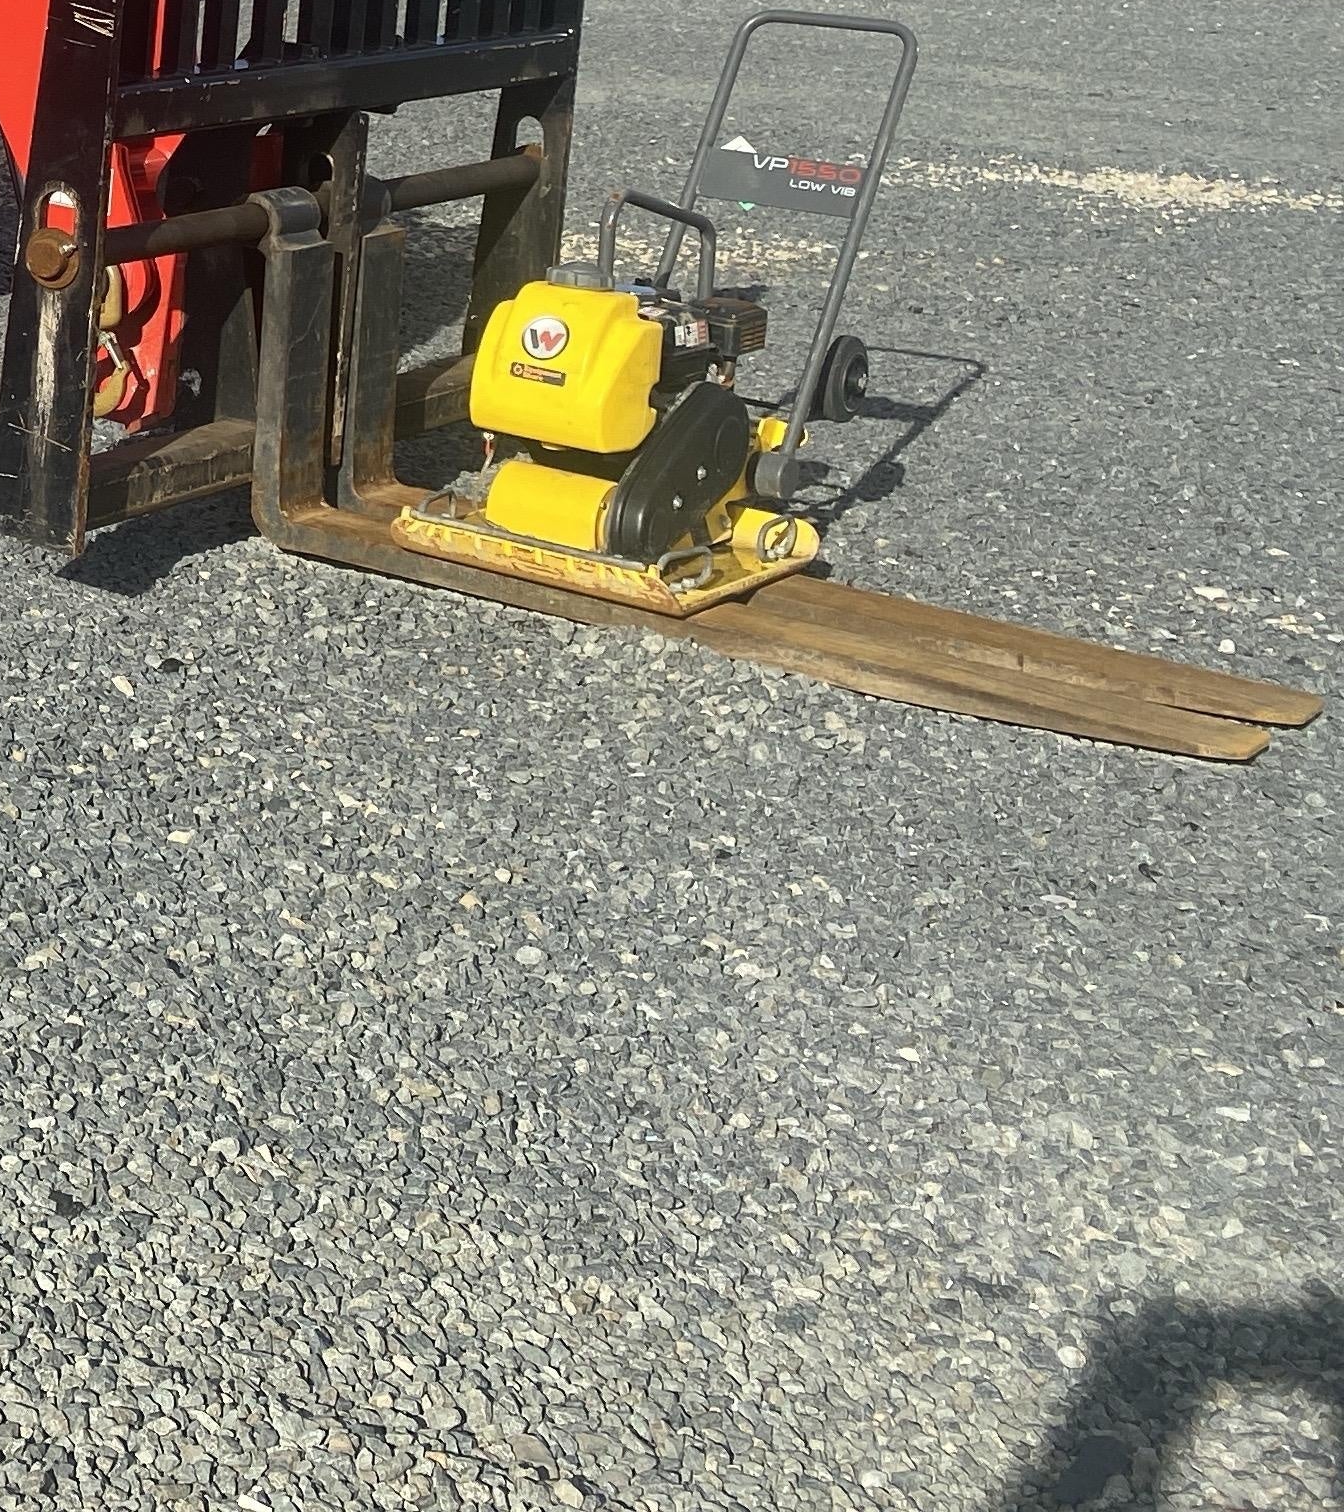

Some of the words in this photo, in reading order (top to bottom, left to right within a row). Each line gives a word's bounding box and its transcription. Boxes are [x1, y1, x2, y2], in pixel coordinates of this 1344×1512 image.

[753, 154, 862, 184] VP1550
[789, 178, 826, 192] LOW
[830, 184, 857, 198] VIB
